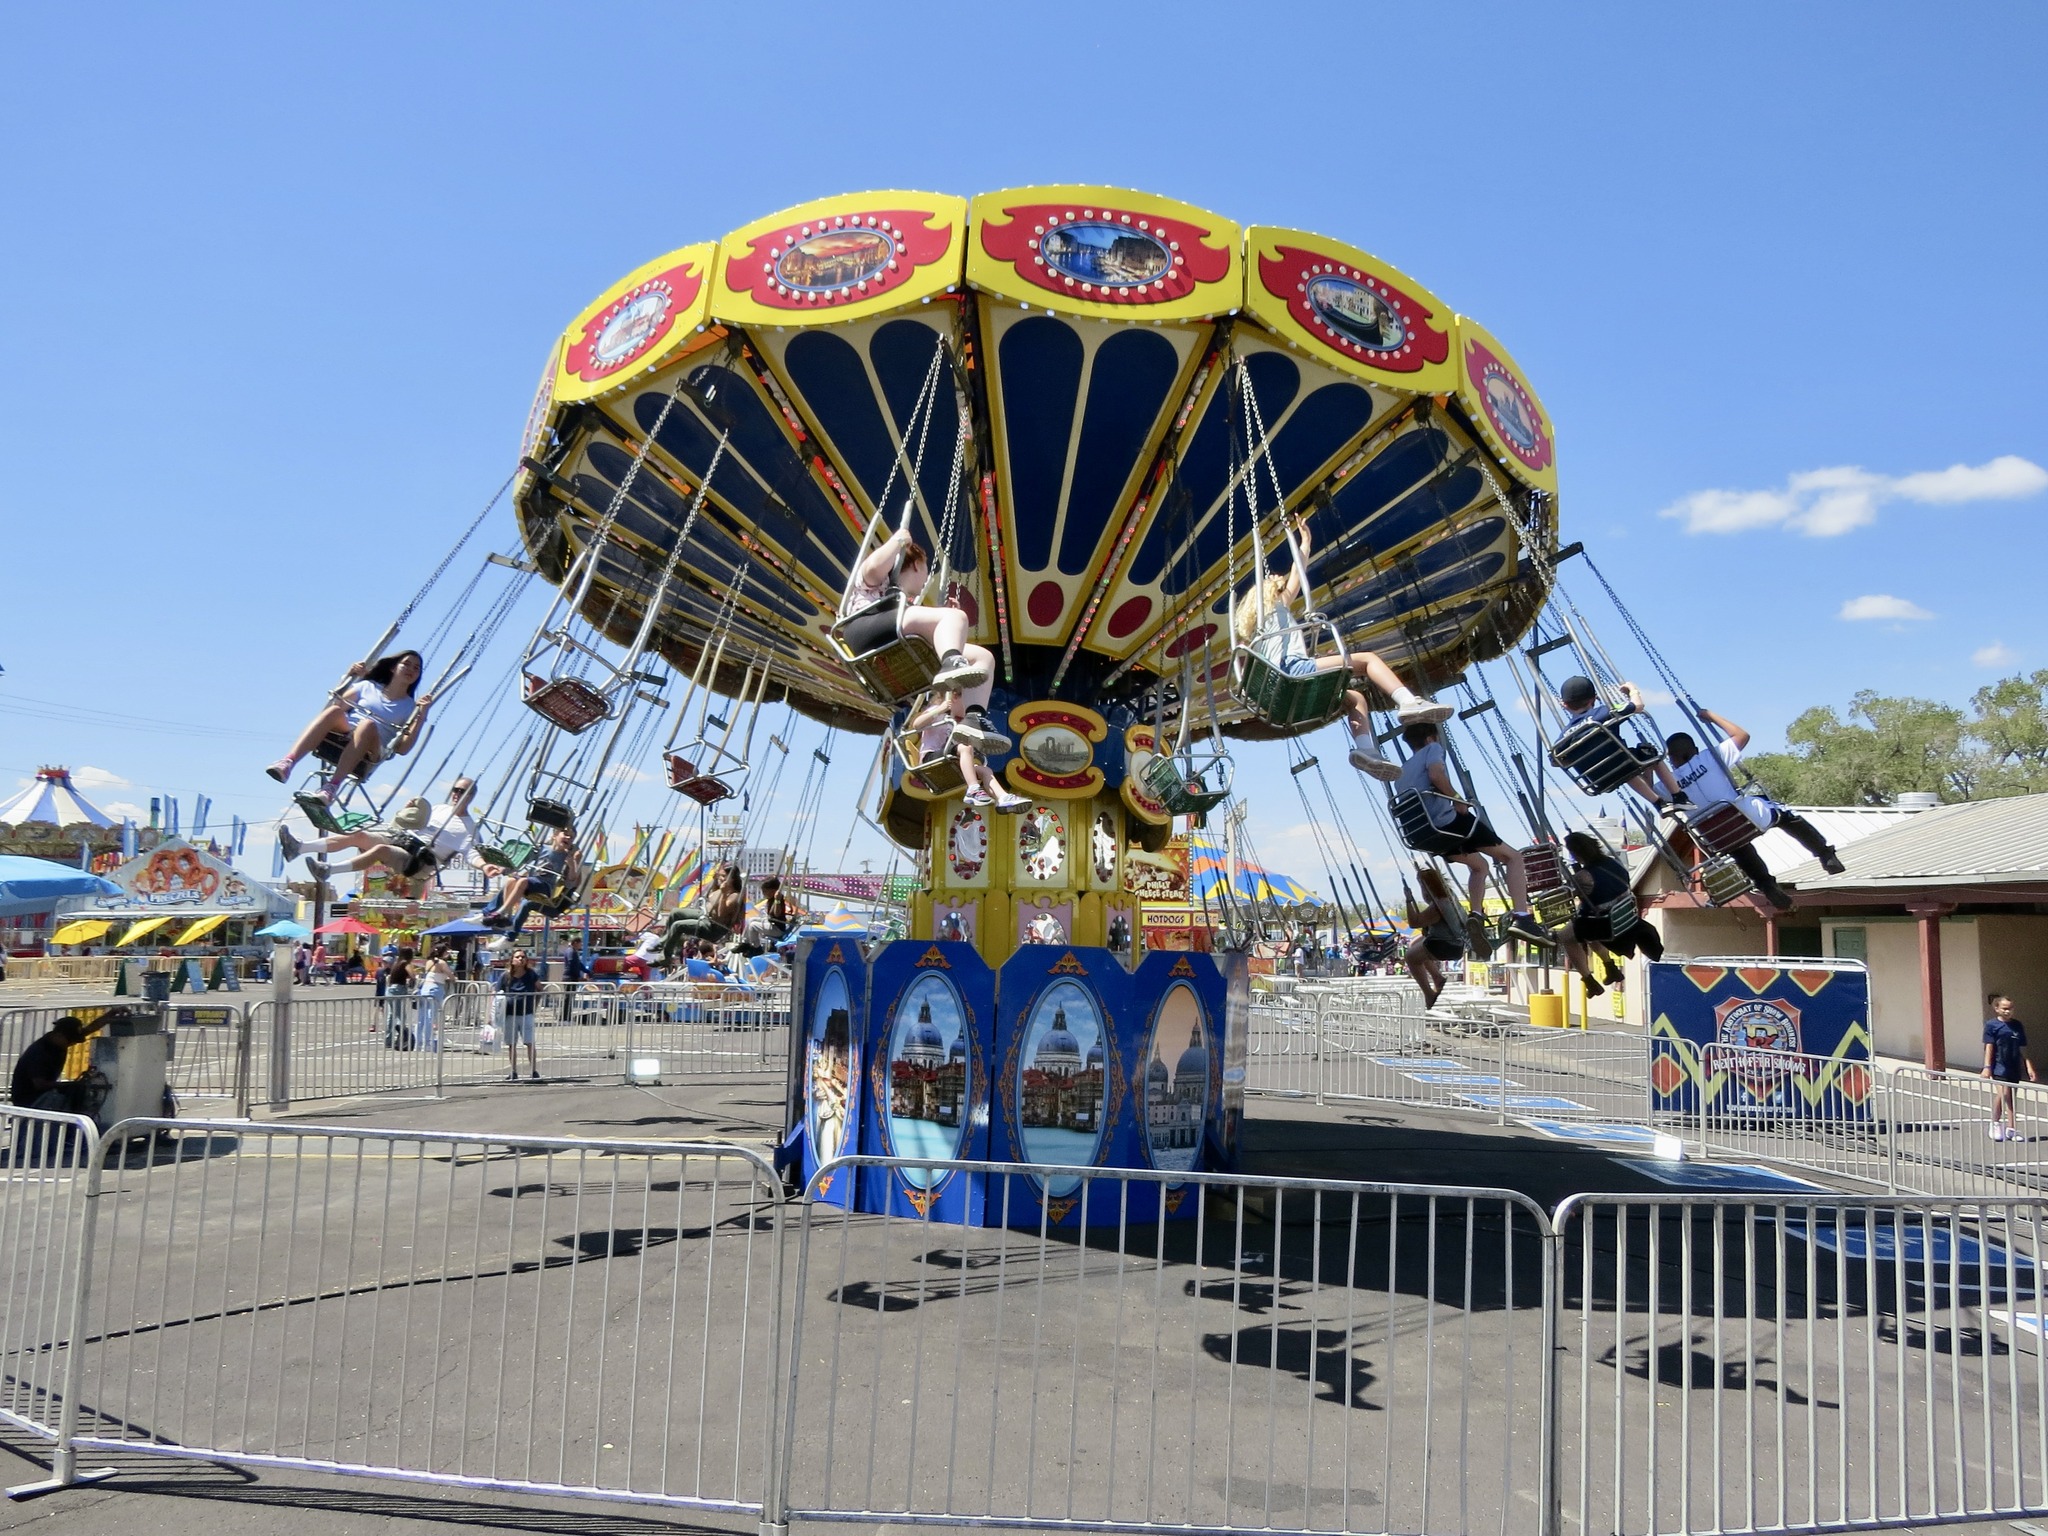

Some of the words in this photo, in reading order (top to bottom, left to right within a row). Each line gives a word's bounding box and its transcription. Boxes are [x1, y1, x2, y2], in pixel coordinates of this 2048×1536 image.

[1147, 880, 1171, 890] PHILLY
[1135, 889, 1161, 899] CHEESE
[1162, 889, 1184, 899] STEAK
[1147, 915, 1185, 923] HOTDOGS
[1722, 1005, 1752, 1033] ARISTOCRAT
[1763, 1005, 1784, 1019] SHOW
[1780, 1018, 1796, 1048] BUSINESS
